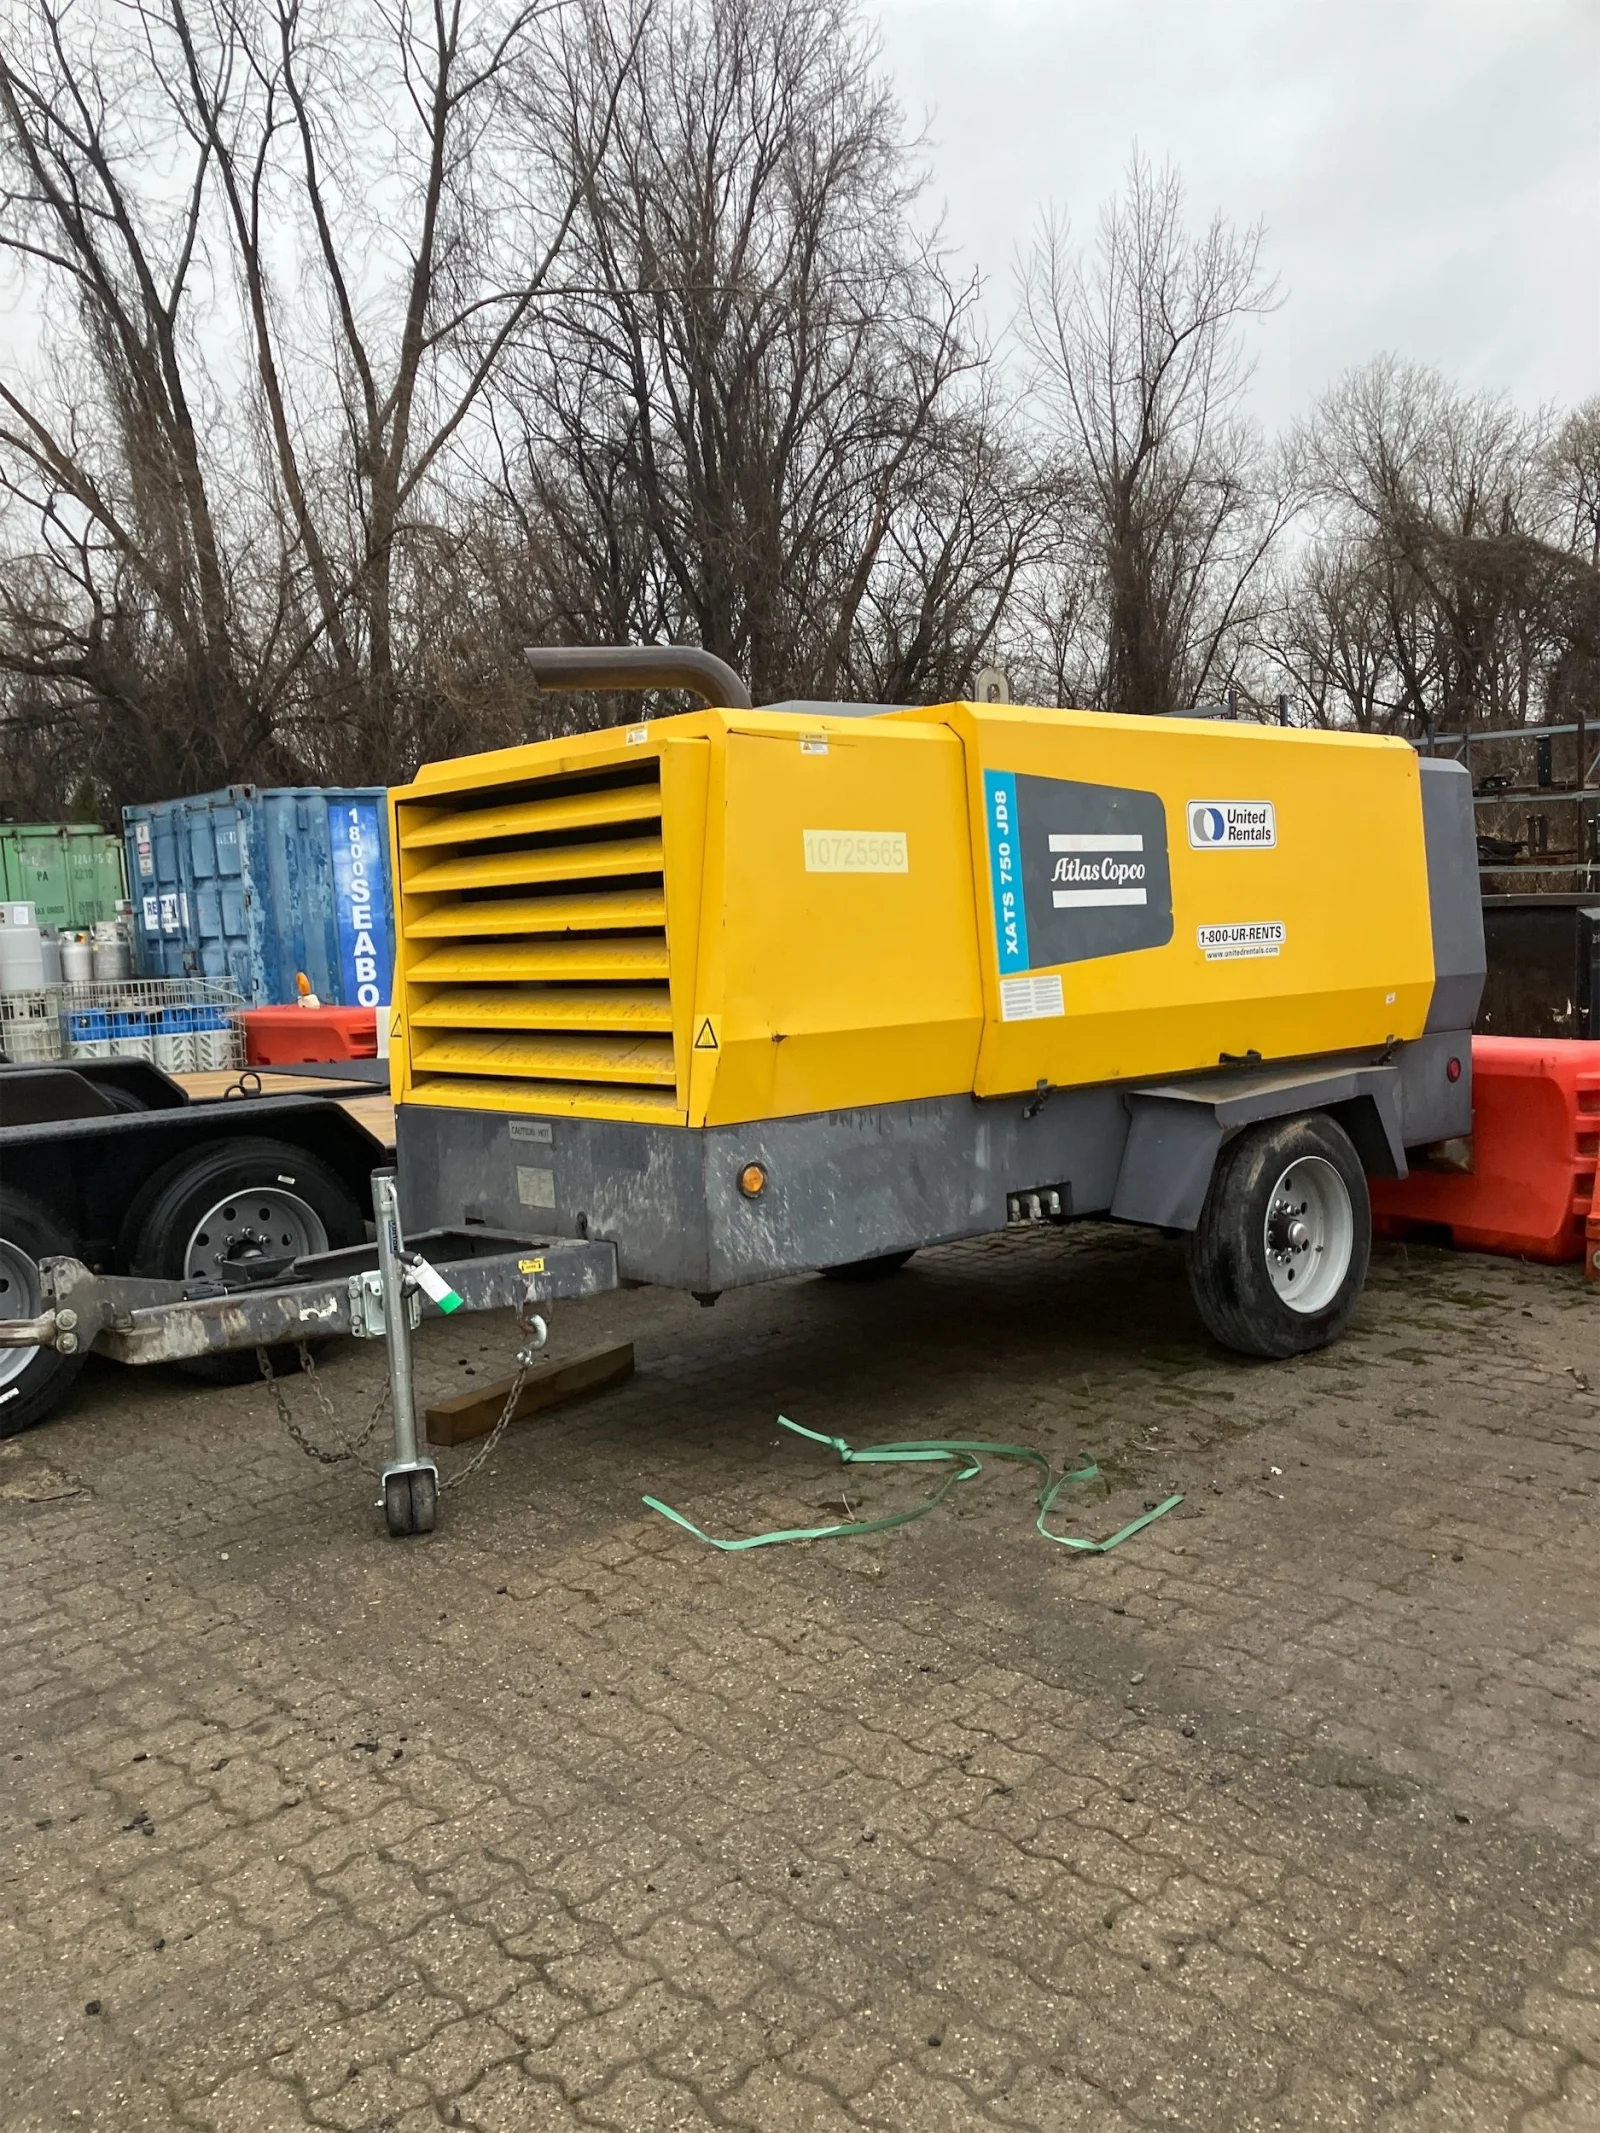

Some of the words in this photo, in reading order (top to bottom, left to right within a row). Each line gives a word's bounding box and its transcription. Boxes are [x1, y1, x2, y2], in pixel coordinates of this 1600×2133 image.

[994, 790, 1009, 836] JD8
[1227, 808, 1267, 825] United
[1228, 825, 1272, 842] Rentals
[806, 837, 904, 866] 10725565
[998, 842, 1013, 885] 750
[1050, 857, 1100, 882] Atlas
[1101, 857, 1146, 885] Copco
[1002, 891, 1019, 955] XATS
[1200, 926, 1282, 943] 1-800-UR-RENTS
[1207, 946, 1279, 959] www.unitedrentals.com
[511, 1126, 536, 1137] CAUTION
